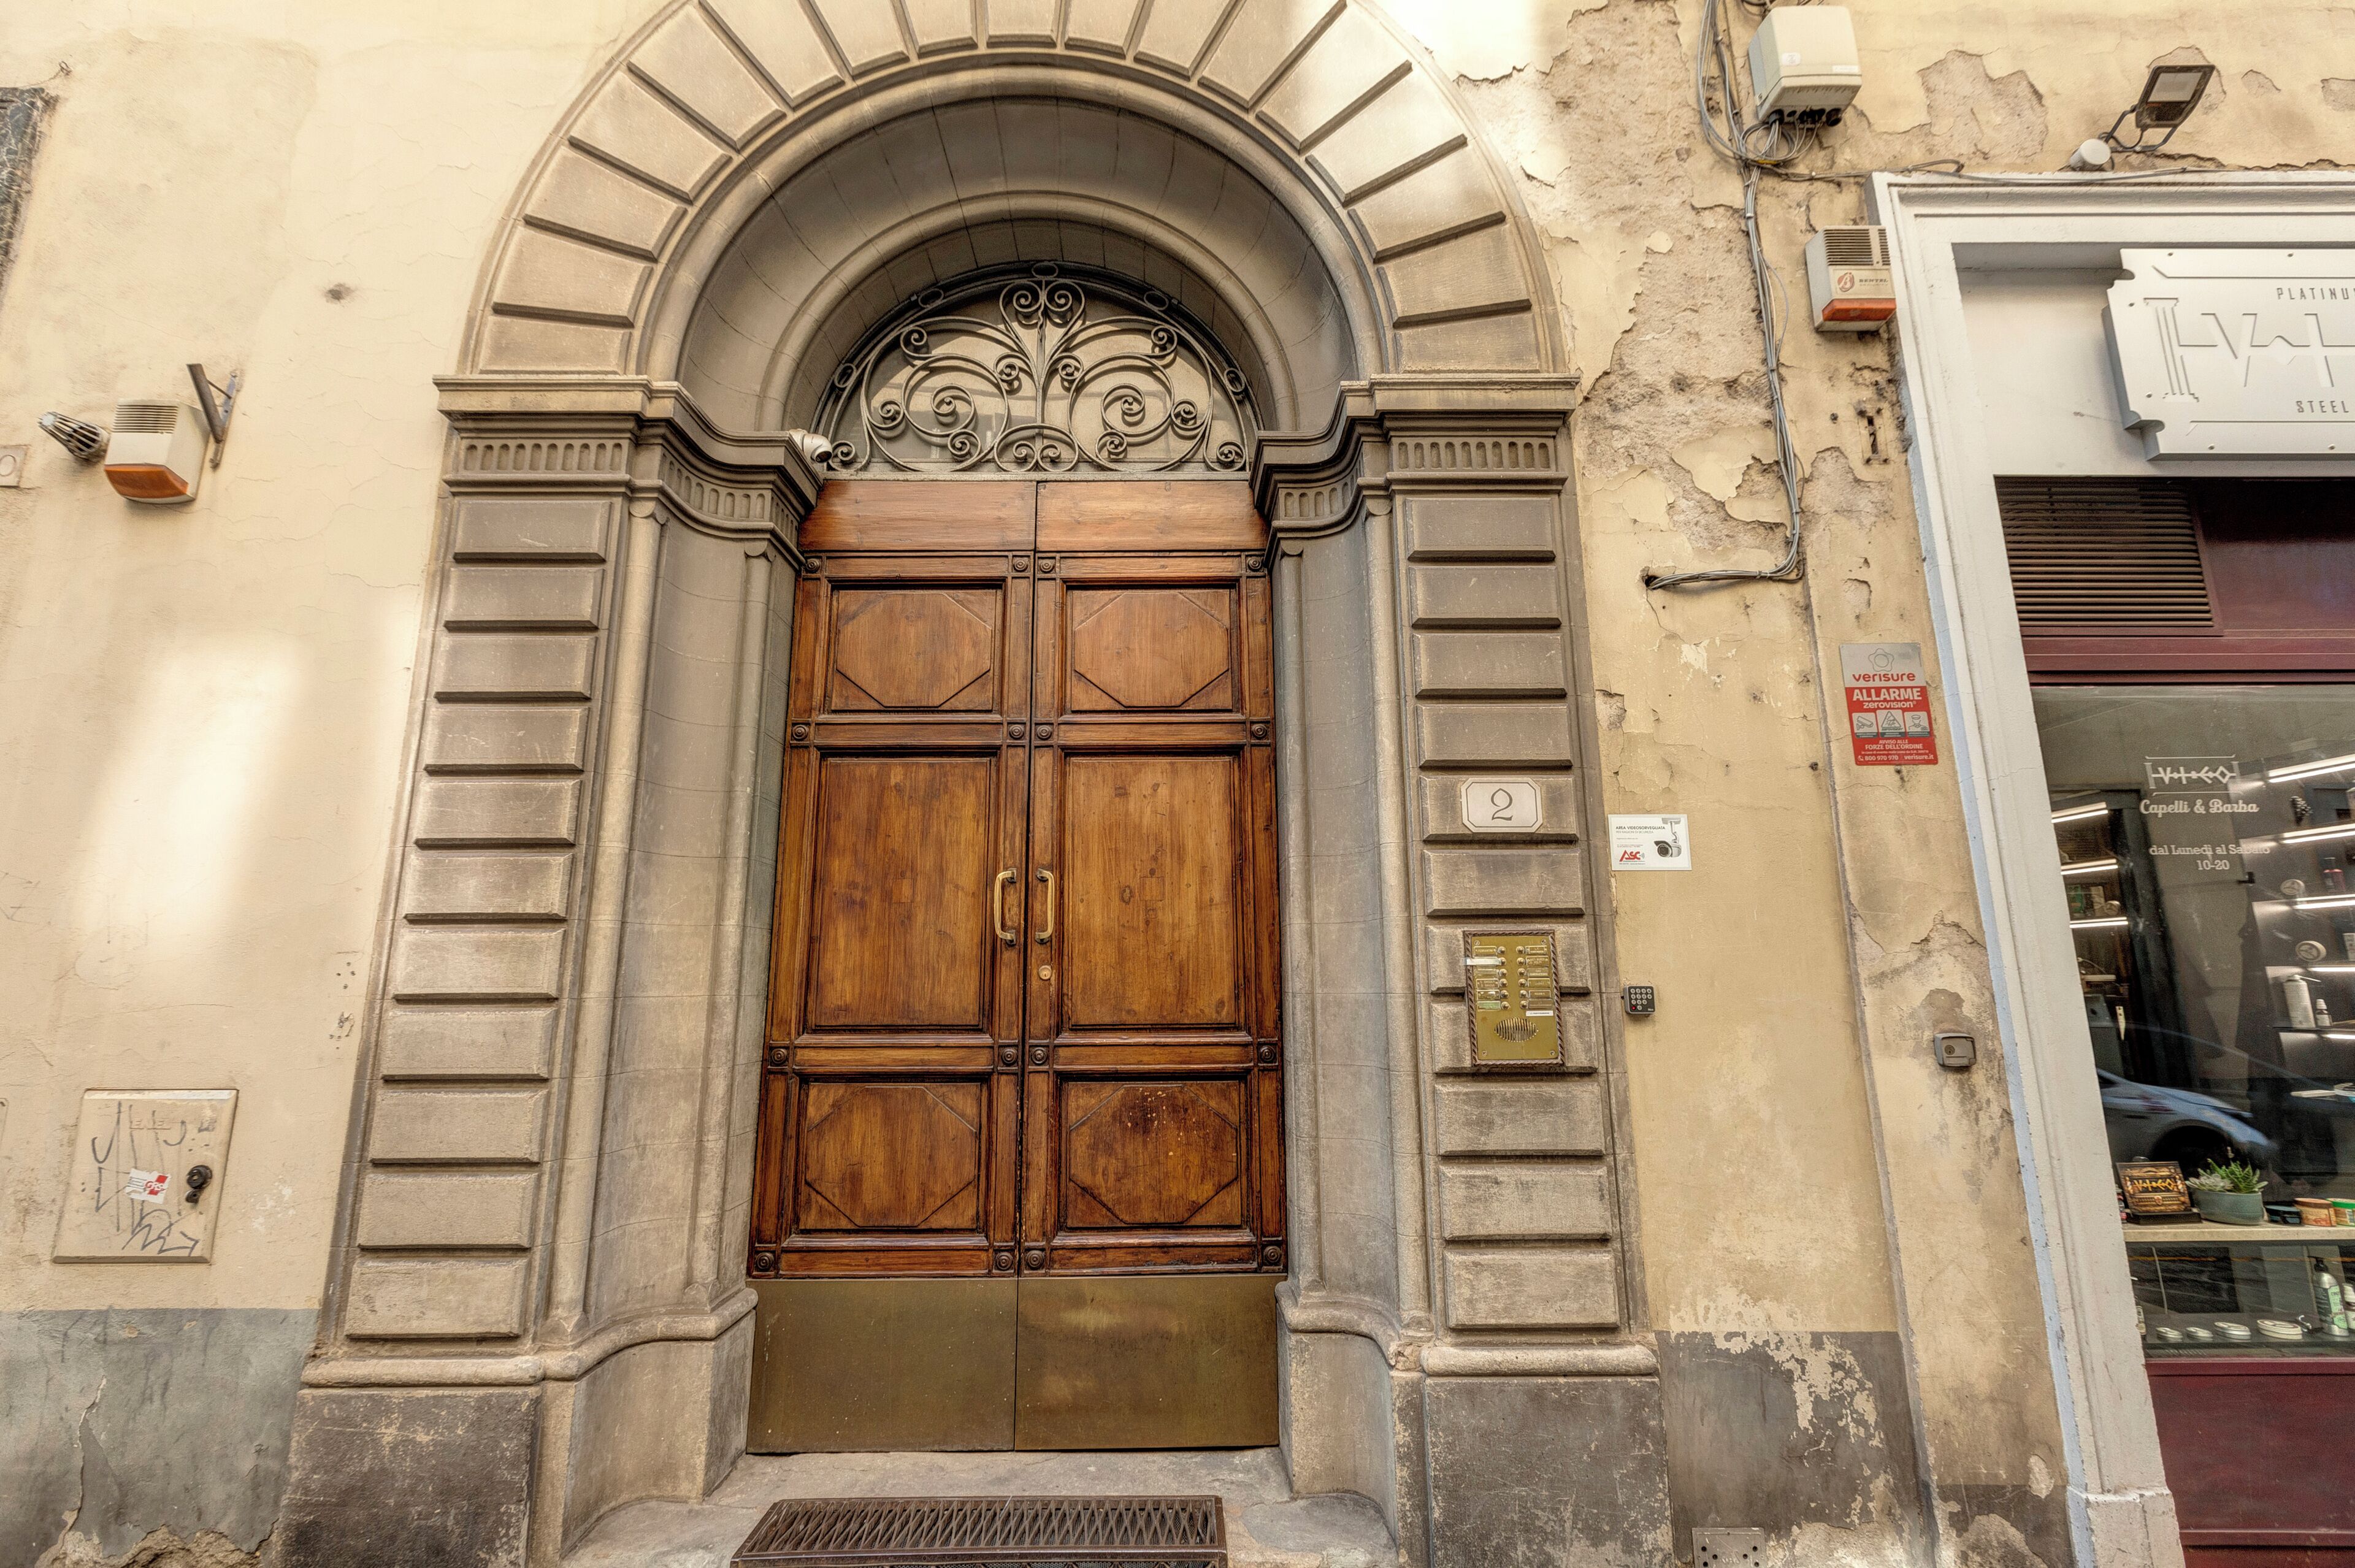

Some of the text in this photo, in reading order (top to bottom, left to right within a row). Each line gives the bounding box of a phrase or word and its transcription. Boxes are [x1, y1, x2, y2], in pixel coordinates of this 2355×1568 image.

[2276, 287, 2355, 300] PLATINU
[2296, 400, 2349, 413] STEEL
[1852, 673, 1916, 682] verisure
[1853, 687, 1923, 701] ALLARME
[1491, 788, 1513, 821] 2
[2140, 798, 2260, 817] Capelli & Barba
[2149, 845, 2169, 855] dal
[2215, 844, 2227, 854] al
[2196, 860, 2230, 870] 10-20
